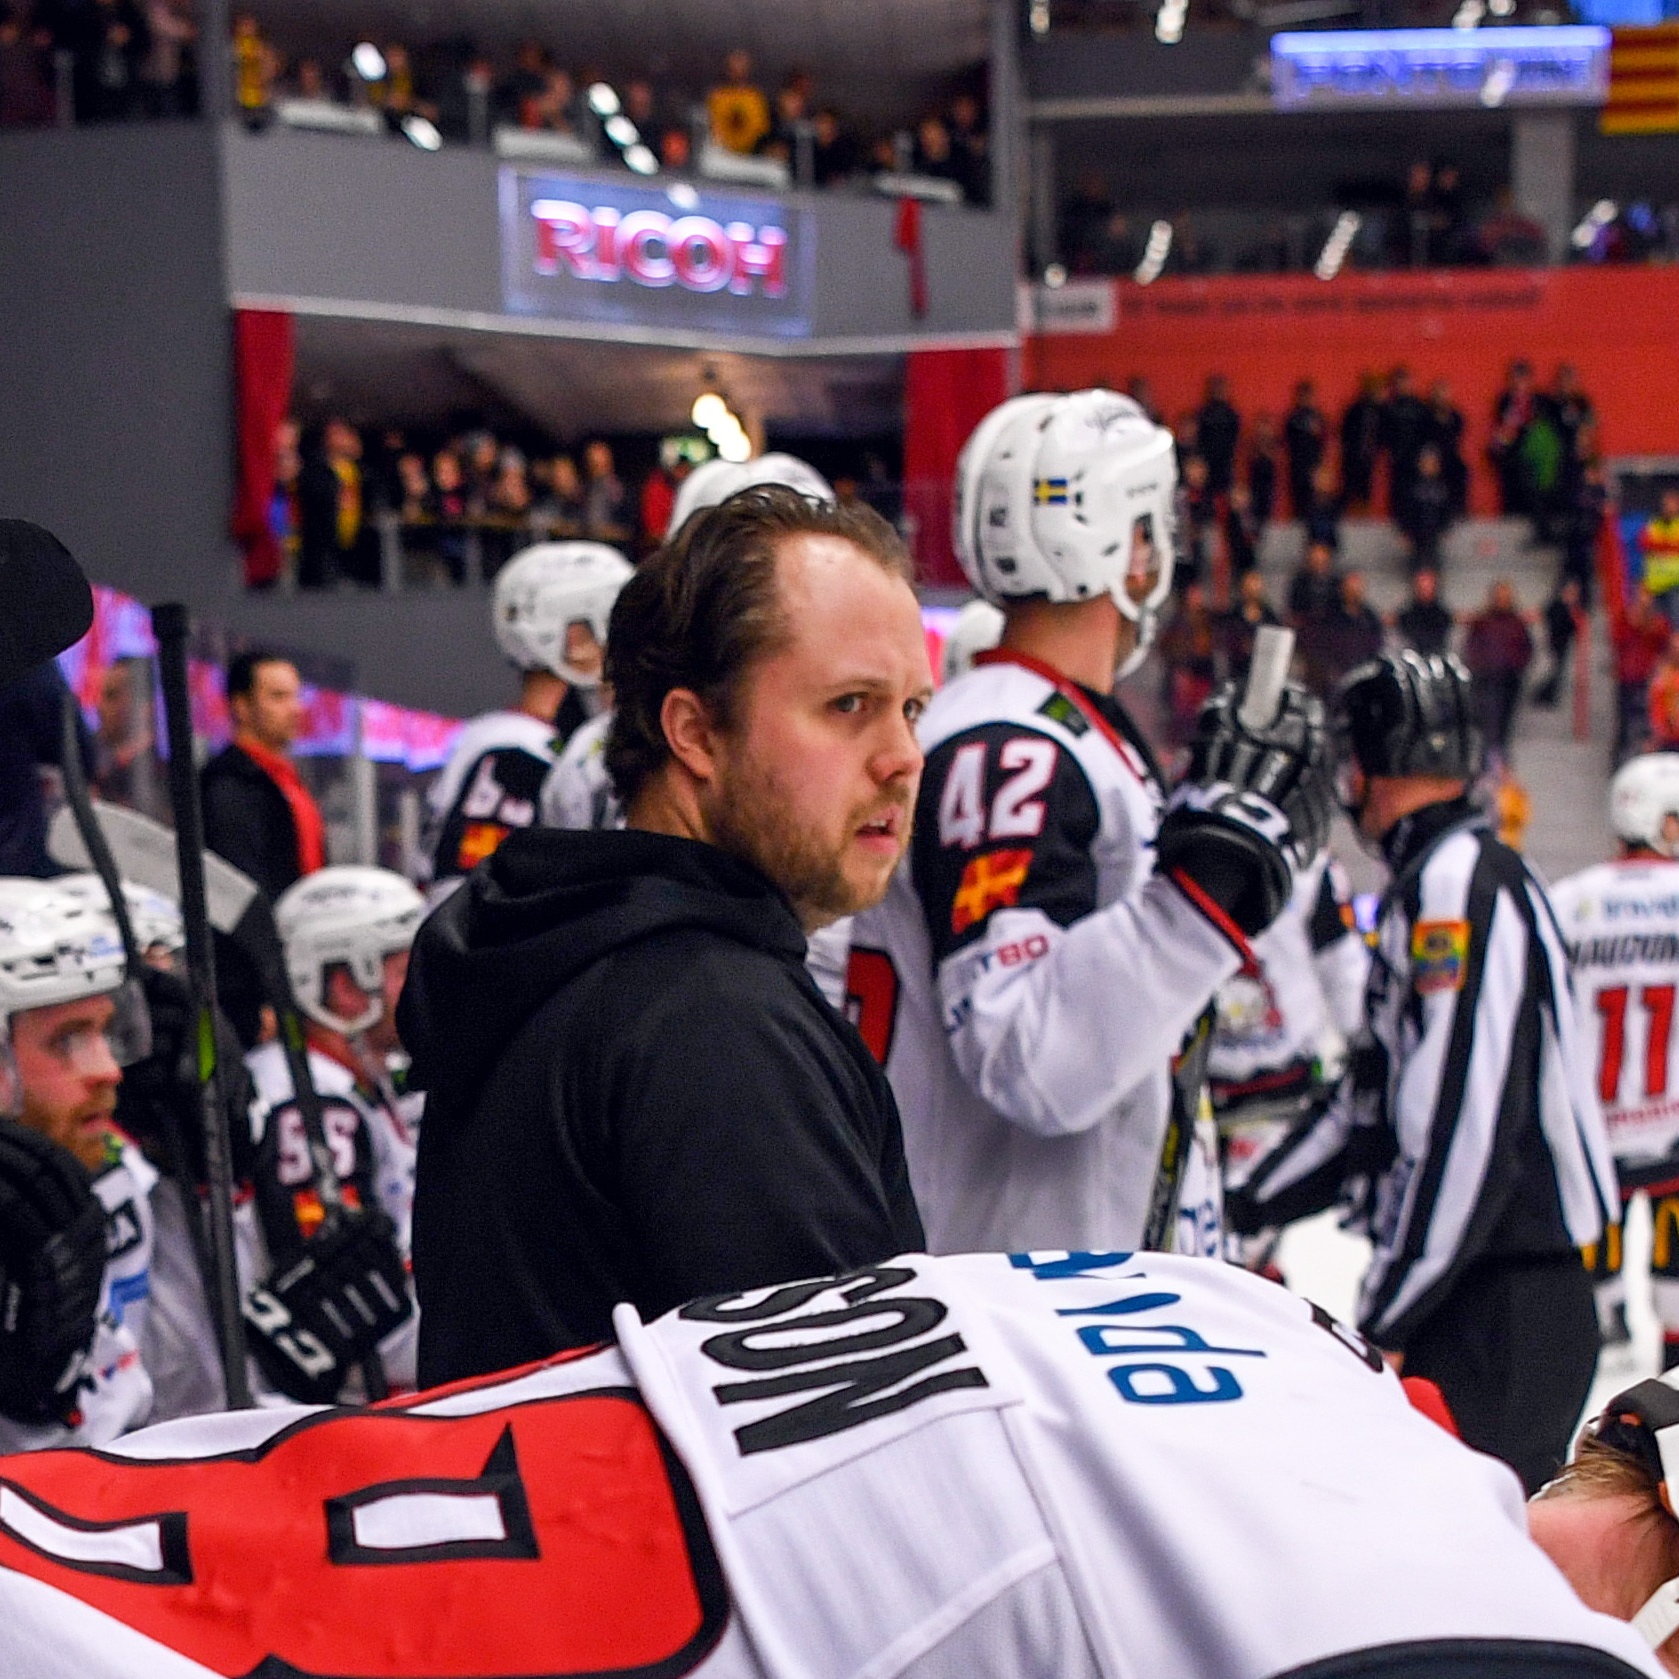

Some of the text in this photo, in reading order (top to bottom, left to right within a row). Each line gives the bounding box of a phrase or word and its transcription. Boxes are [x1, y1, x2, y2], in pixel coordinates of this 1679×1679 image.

[529, 198, 788, 299] RICOH
[939, 737, 1058, 851] 42
[1596, 984, 1676, 1102] 11
